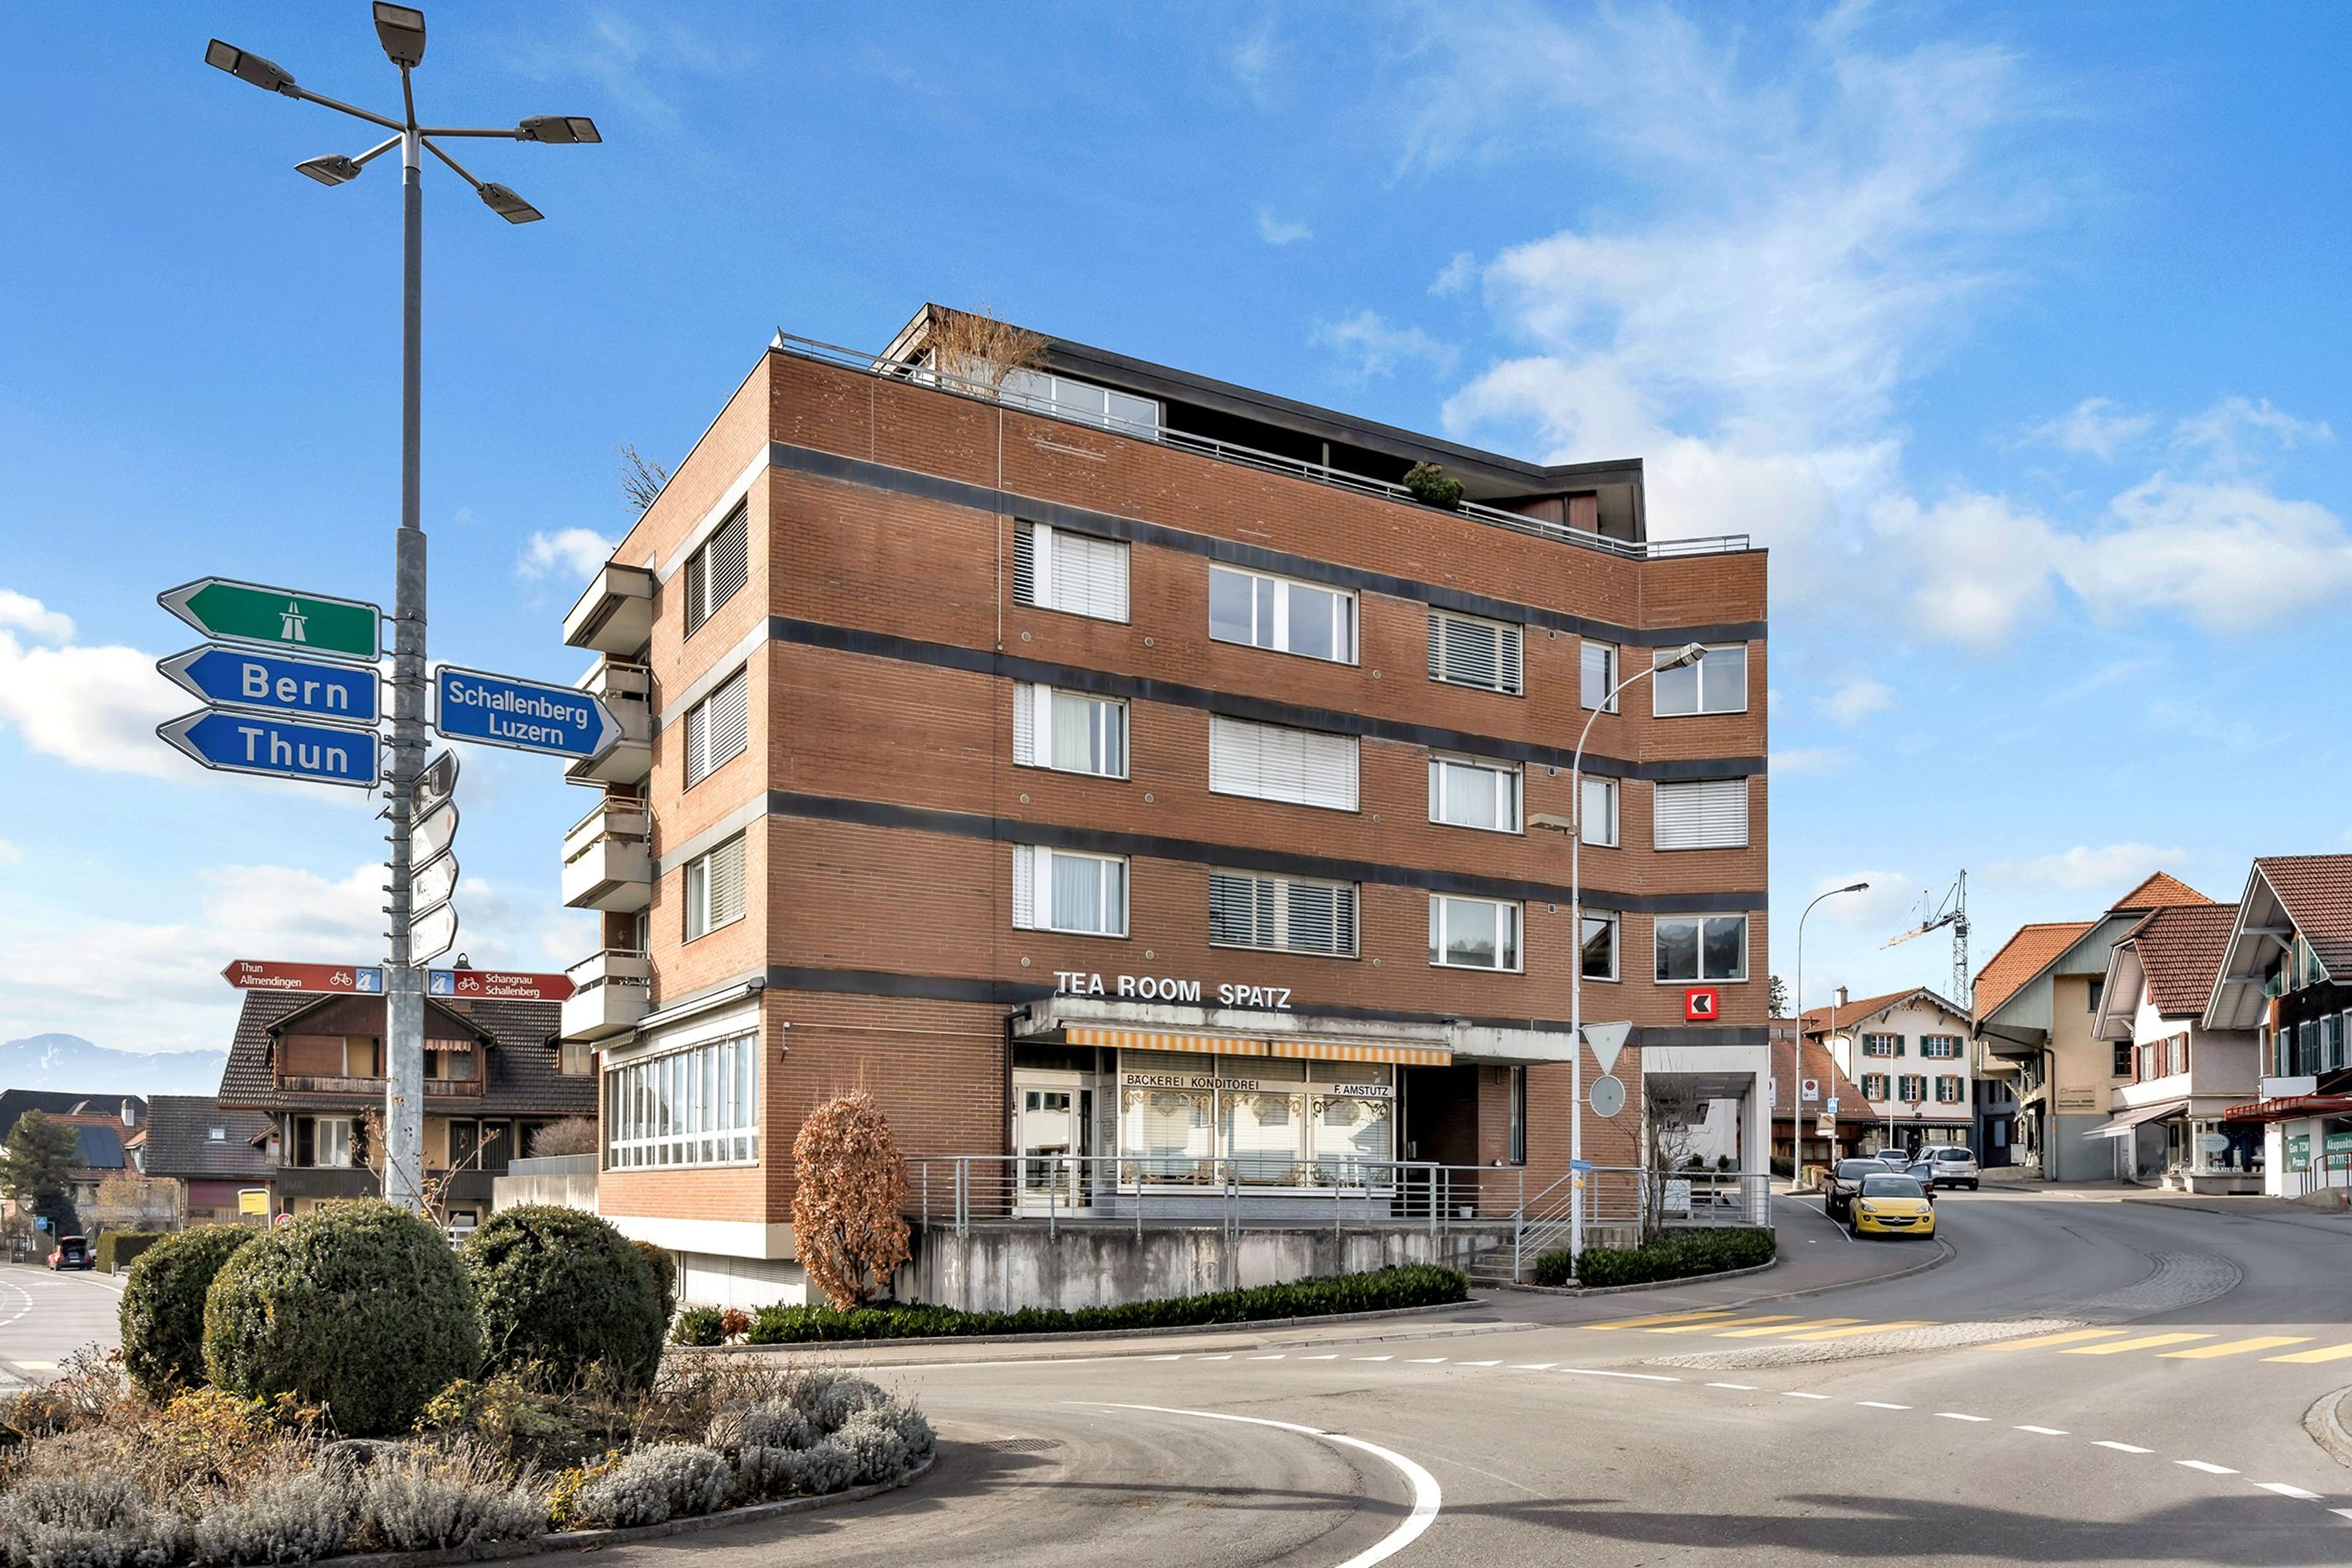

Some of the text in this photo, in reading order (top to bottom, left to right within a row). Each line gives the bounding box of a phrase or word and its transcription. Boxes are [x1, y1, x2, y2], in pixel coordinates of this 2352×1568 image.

[242, 663, 348, 709] Bern
[448, 681, 588, 729] Schallenberg
[489, 712, 564, 745] Luzern
[238, 726, 348, 774] Thun
[239, 962, 263, 973] Thun
[239, 975, 302, 989] Allmendingen
[485, 973, 533, 986] Schangnau
[485, 986, 540, 999] Schallenberg
[1053, 971, 1292, 1009] TEA ROOM SPATZ
[1127, 1074, 1259, 1090] BÄCKEREI KONDITOREI
[1335, 1085, 1389, 1096] F. AMSTUTZ
[2293, 1157, 2305, 1166] Praxis
